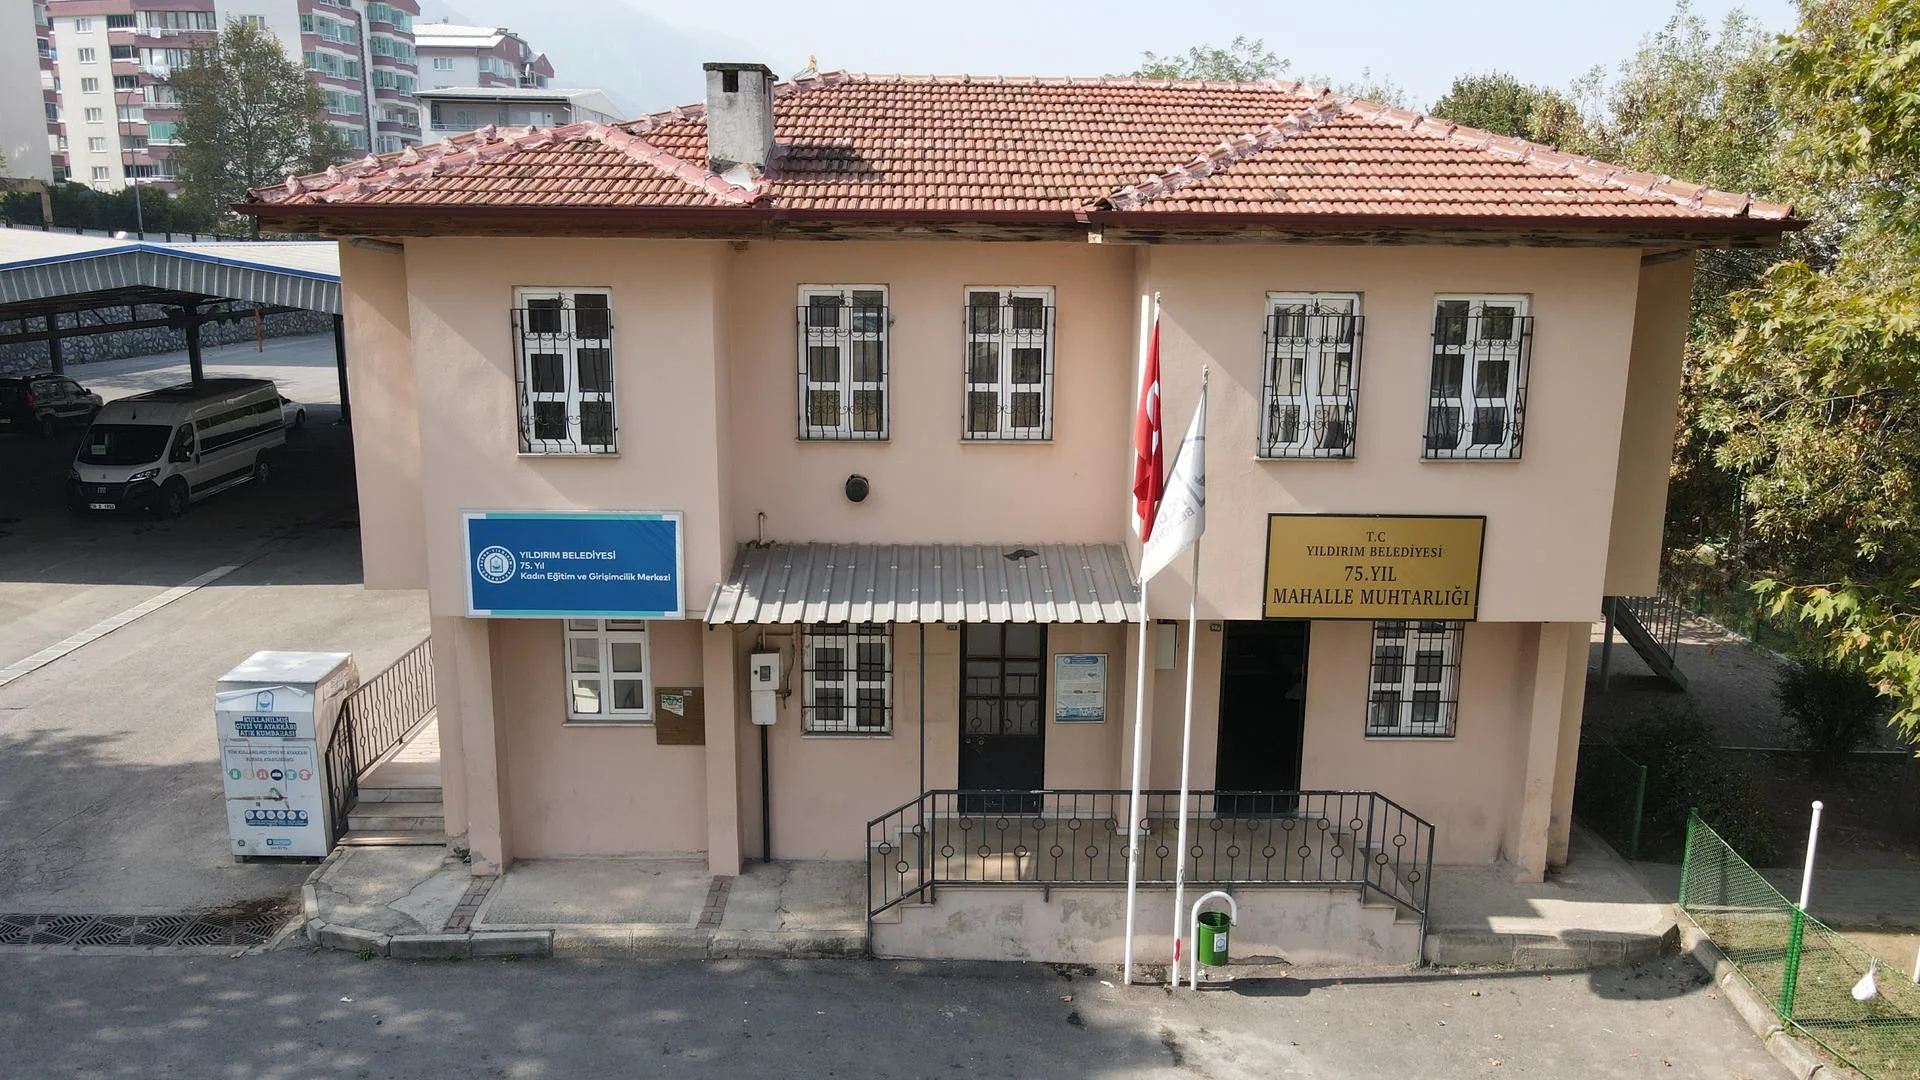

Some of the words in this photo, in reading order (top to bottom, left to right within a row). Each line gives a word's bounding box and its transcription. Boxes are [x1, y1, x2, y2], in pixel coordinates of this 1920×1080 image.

[1366, 531, 1386, 542] T.C
[519, 551, 560, 560] YILDIRIM
[562, 550, 616, 560] BELEDİYESİ
[1306, 546, 1366, 557] YILDIRIM
[1370, 544, 1443, 558] BELEDİYESİ
[520, 562, 533, 570] 75.
[535, 562, 545, 570] Yıl
[520, 572, 546, 580] Kadın
[547, 572, 575, 582] Eğitim
[588, 572, 635, 582] Girişimcilik
[637, 573, 671, 582] Merkezi
[1344, 565, 1397, 582] 75.YIL
[1273, 588, 1354, 605] MAHALLE
[1360, 585, 1470, 606] MUHTARLIĞI
